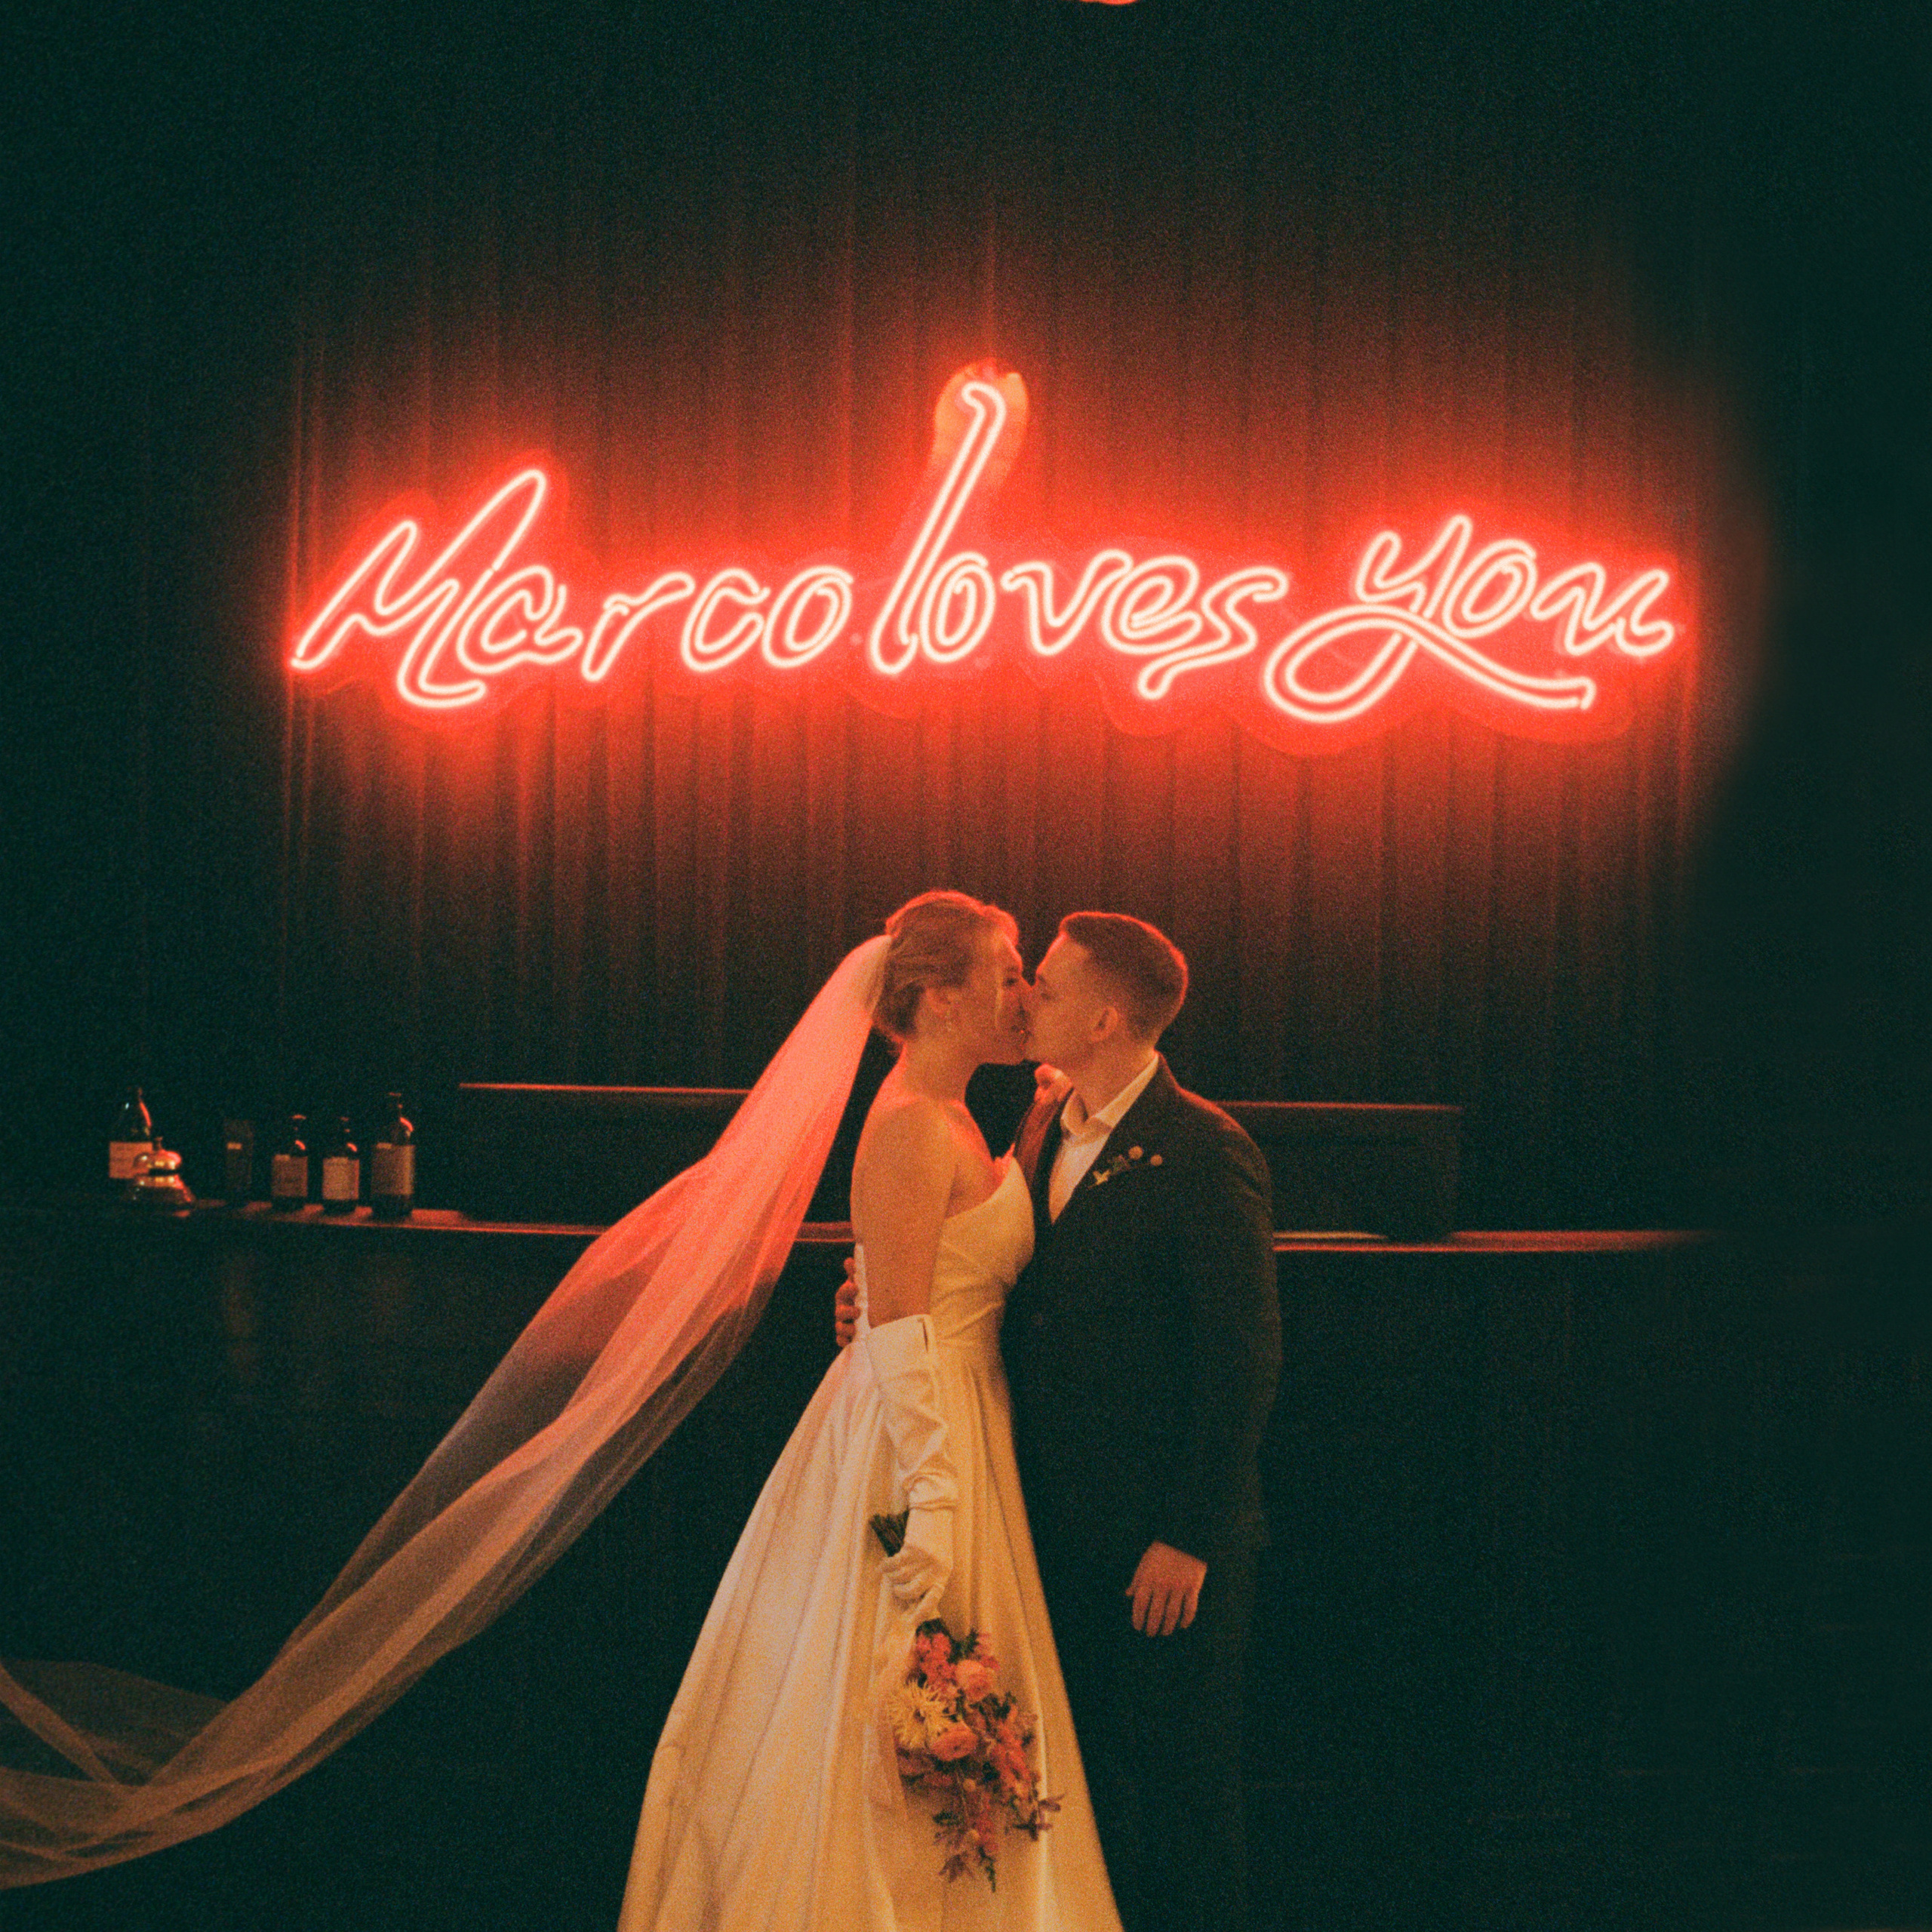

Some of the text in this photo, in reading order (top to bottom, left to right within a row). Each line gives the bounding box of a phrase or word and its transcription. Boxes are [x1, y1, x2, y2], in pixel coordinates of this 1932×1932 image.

[289, 380, 1676, 724] Marco loves you
